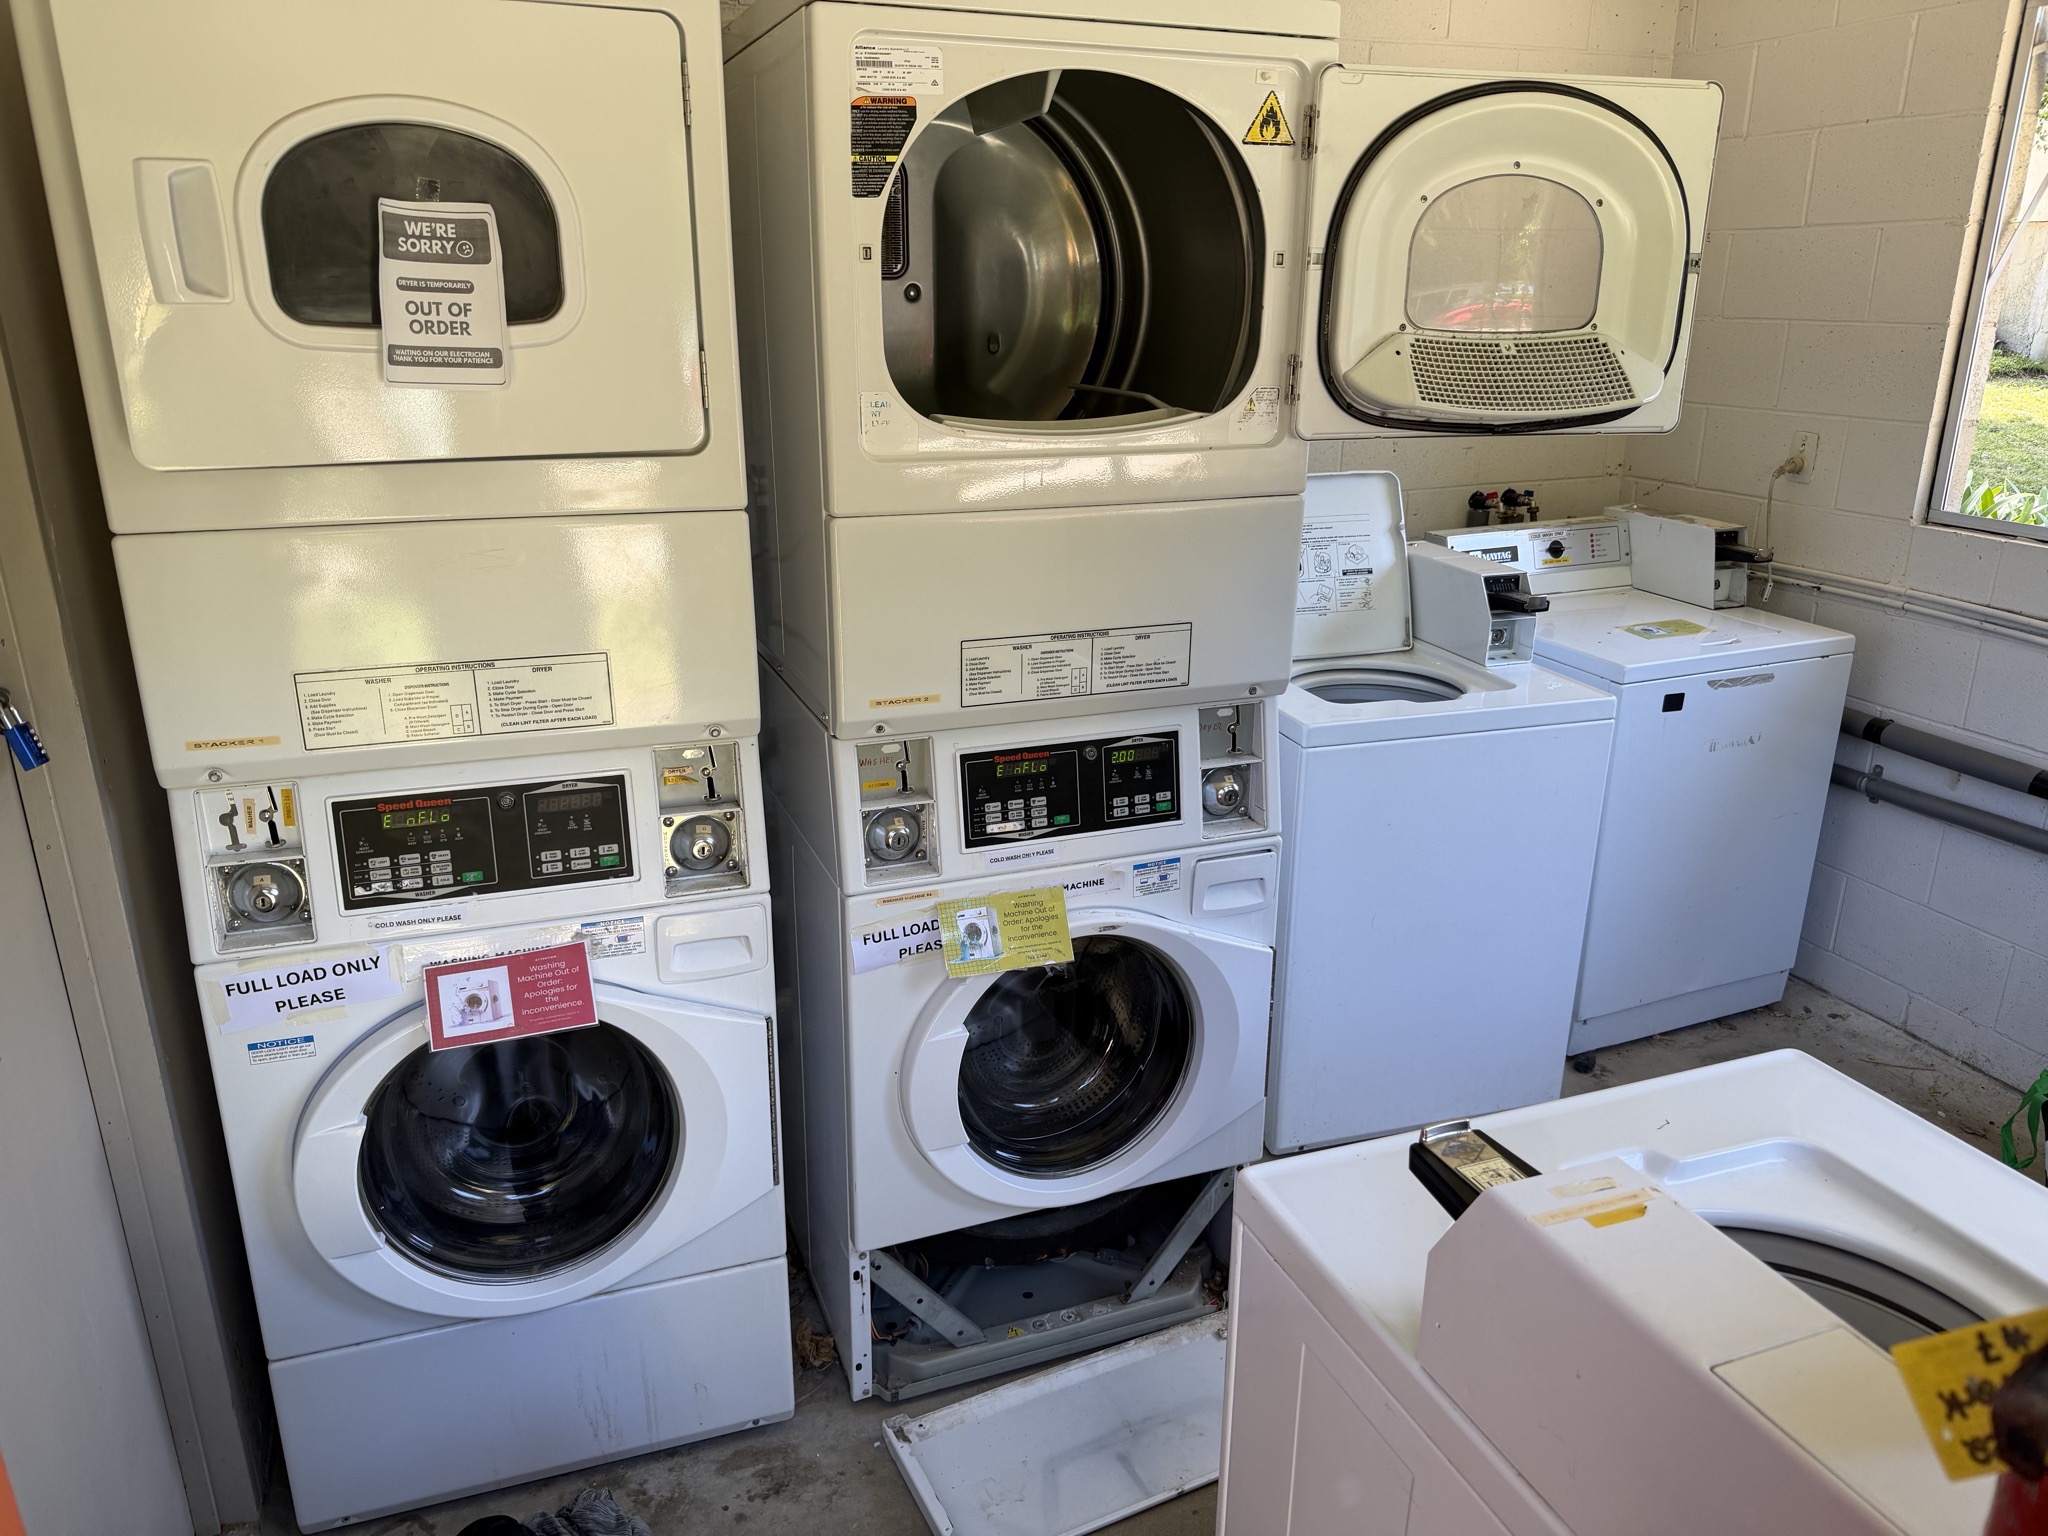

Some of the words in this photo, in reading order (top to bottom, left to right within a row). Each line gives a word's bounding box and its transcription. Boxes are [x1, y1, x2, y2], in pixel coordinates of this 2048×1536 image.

[398, 237, 454, 254] SORRY
[398, 279, 418, 287] DRYER
[427, 281, 471, 289] TEMPORARILY
[405, 300, 442, 316] OUT
[448, 302, 472, 318] OF
[409, 320, 472, 336] ORDER
[1482, 551, 1512, 560] MAYTAG
[415, 665, 450, 673] OPERATING
[451, 662, 496, 670] INSTRUCTIONS
[364, 677, 392, 685] WASHER
[875, 698, 922, 706] STACKER
[194, 739, 255, 749] STACKER
[994, 754, 1022, 763] Speed
[1023, 751, 1050, 759] Queen
[1112, 750, 1134, 763] 2.00
[377, 800, 414, 812] Speed
[414, 798, 452, 808] Queen
[1063, 878, 1105, 891] MACHINE
[882, 896, 904, 904] WASHING
[1013, 900, 1043, 908] Washing
[1004, 909, 1033, 917] Machine
[1026, 914, 1058, 924] Apologies
[375, 921, 394, 929] COLD
[395, 919, 417, 927] WASH
[418, 917, 436, 926] ONLY
[437, 914, 462, 923] PLEASE
[863, 928, 900, 945] FULL
[903, 919, 940, 937] LOAD
[1008, 930, 1059, 942] inconvenience.
[899, 940, 943, 958] PLEAS
[529, 961, 566, 972] Washing
[225, 978, 273, 997] FULL
[276, 967, 328, 988] LOAD
[332, 955, 381, 977] ONLY
[518, 971, 552, 983] Machine
[555, 968, 569, 976] Out
[537, 979, 563, 988] Order:
[524, 987, 565, 999] Apologies
[275, 988, 346, 1013] PLEASE
[522, 1000, 584, 1015] inconvenience.
[257, 1037, 305, 1049] NOTICE
